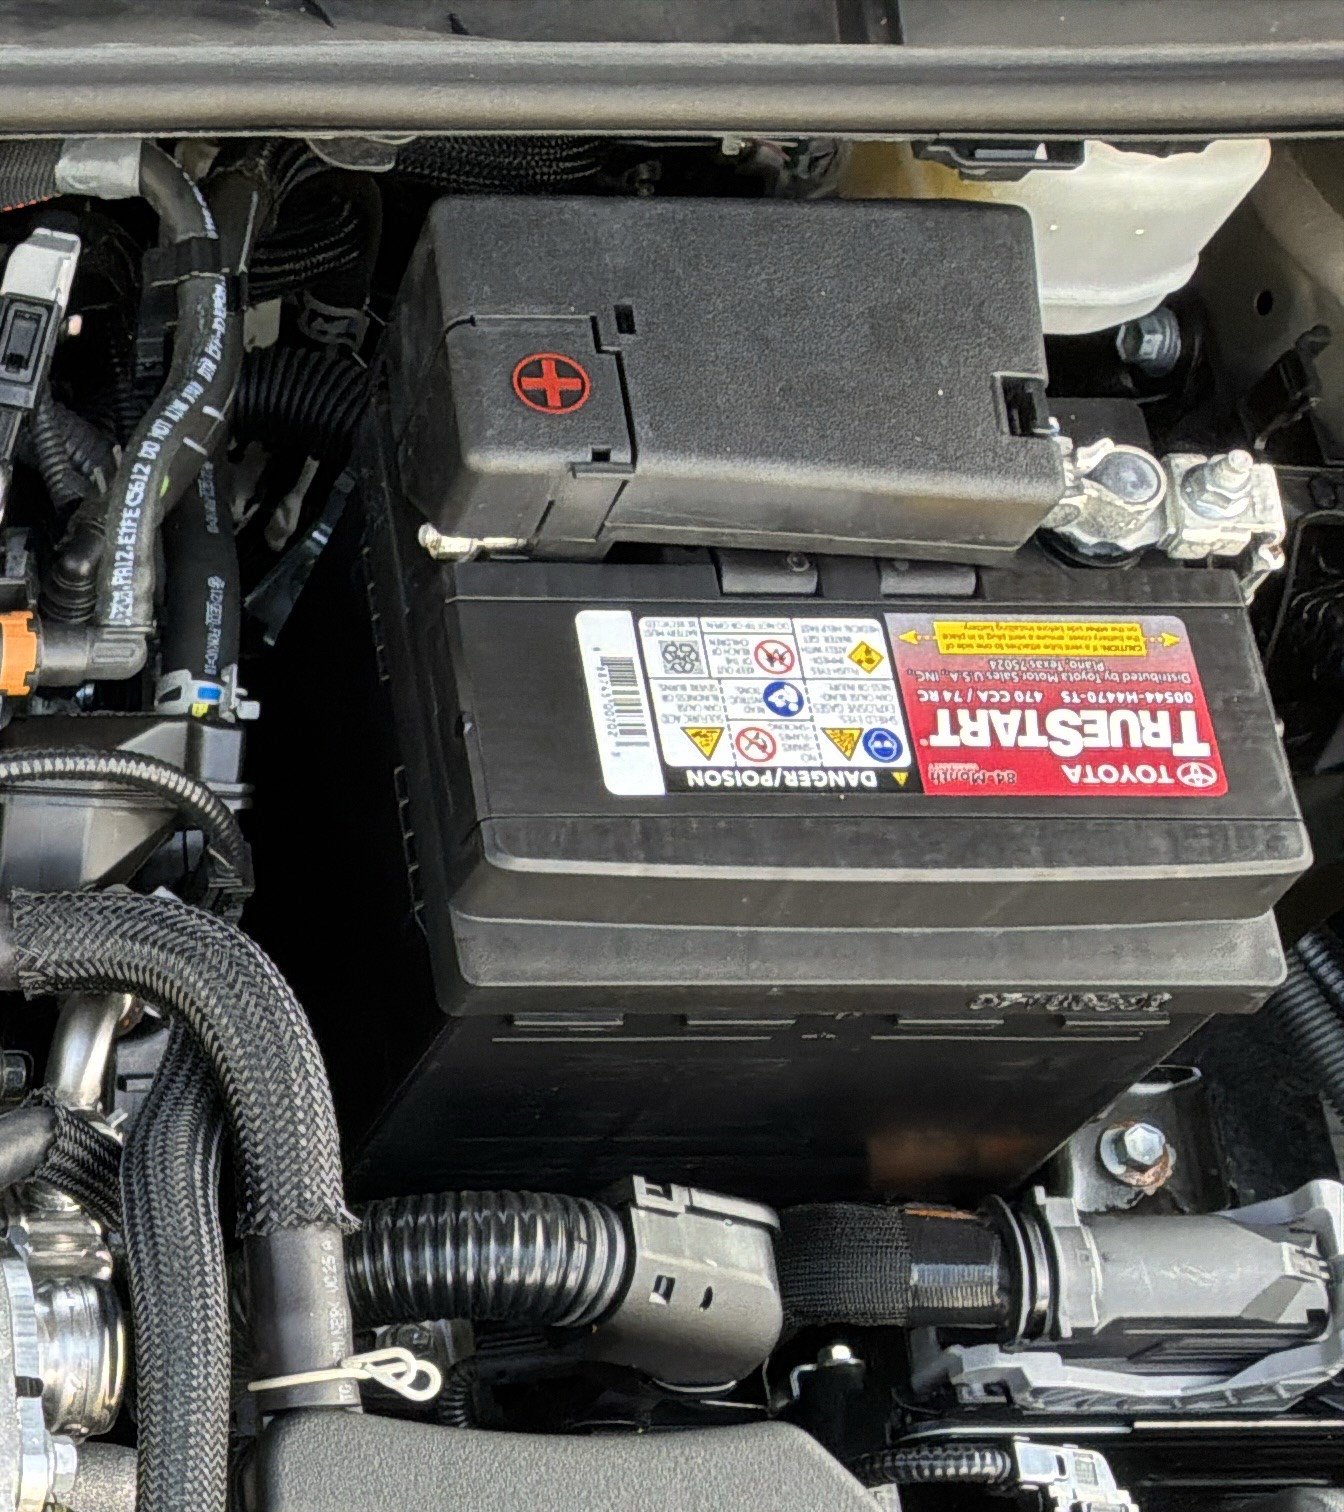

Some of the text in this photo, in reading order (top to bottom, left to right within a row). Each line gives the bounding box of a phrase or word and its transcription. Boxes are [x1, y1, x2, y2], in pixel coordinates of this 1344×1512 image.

[989, 658, 1105, 671] Plano, Texas 75024
[986, 671, 1019, 683] Sales
[1023, 671, 1059, 683] Motor
[1061, 671, 1101, 684] Toyota
[1105, 670, 1120, 684] by
[1123, 672, 1192, 684] Distributed
[916, 689, 940, 703] RC
[942, 690, 963, 703] 74
[977, 690, 1011, 703] CCA
[1014, 690, 1043, 703] 470
[1061, 690, 1194, 704] 00544-H4470-TS
[685, 769, 878, 788] DANGER/POISON
[928, 769, 1017, 785] 84-Month
[1061, 764, 1175, 784] TOYOTA
